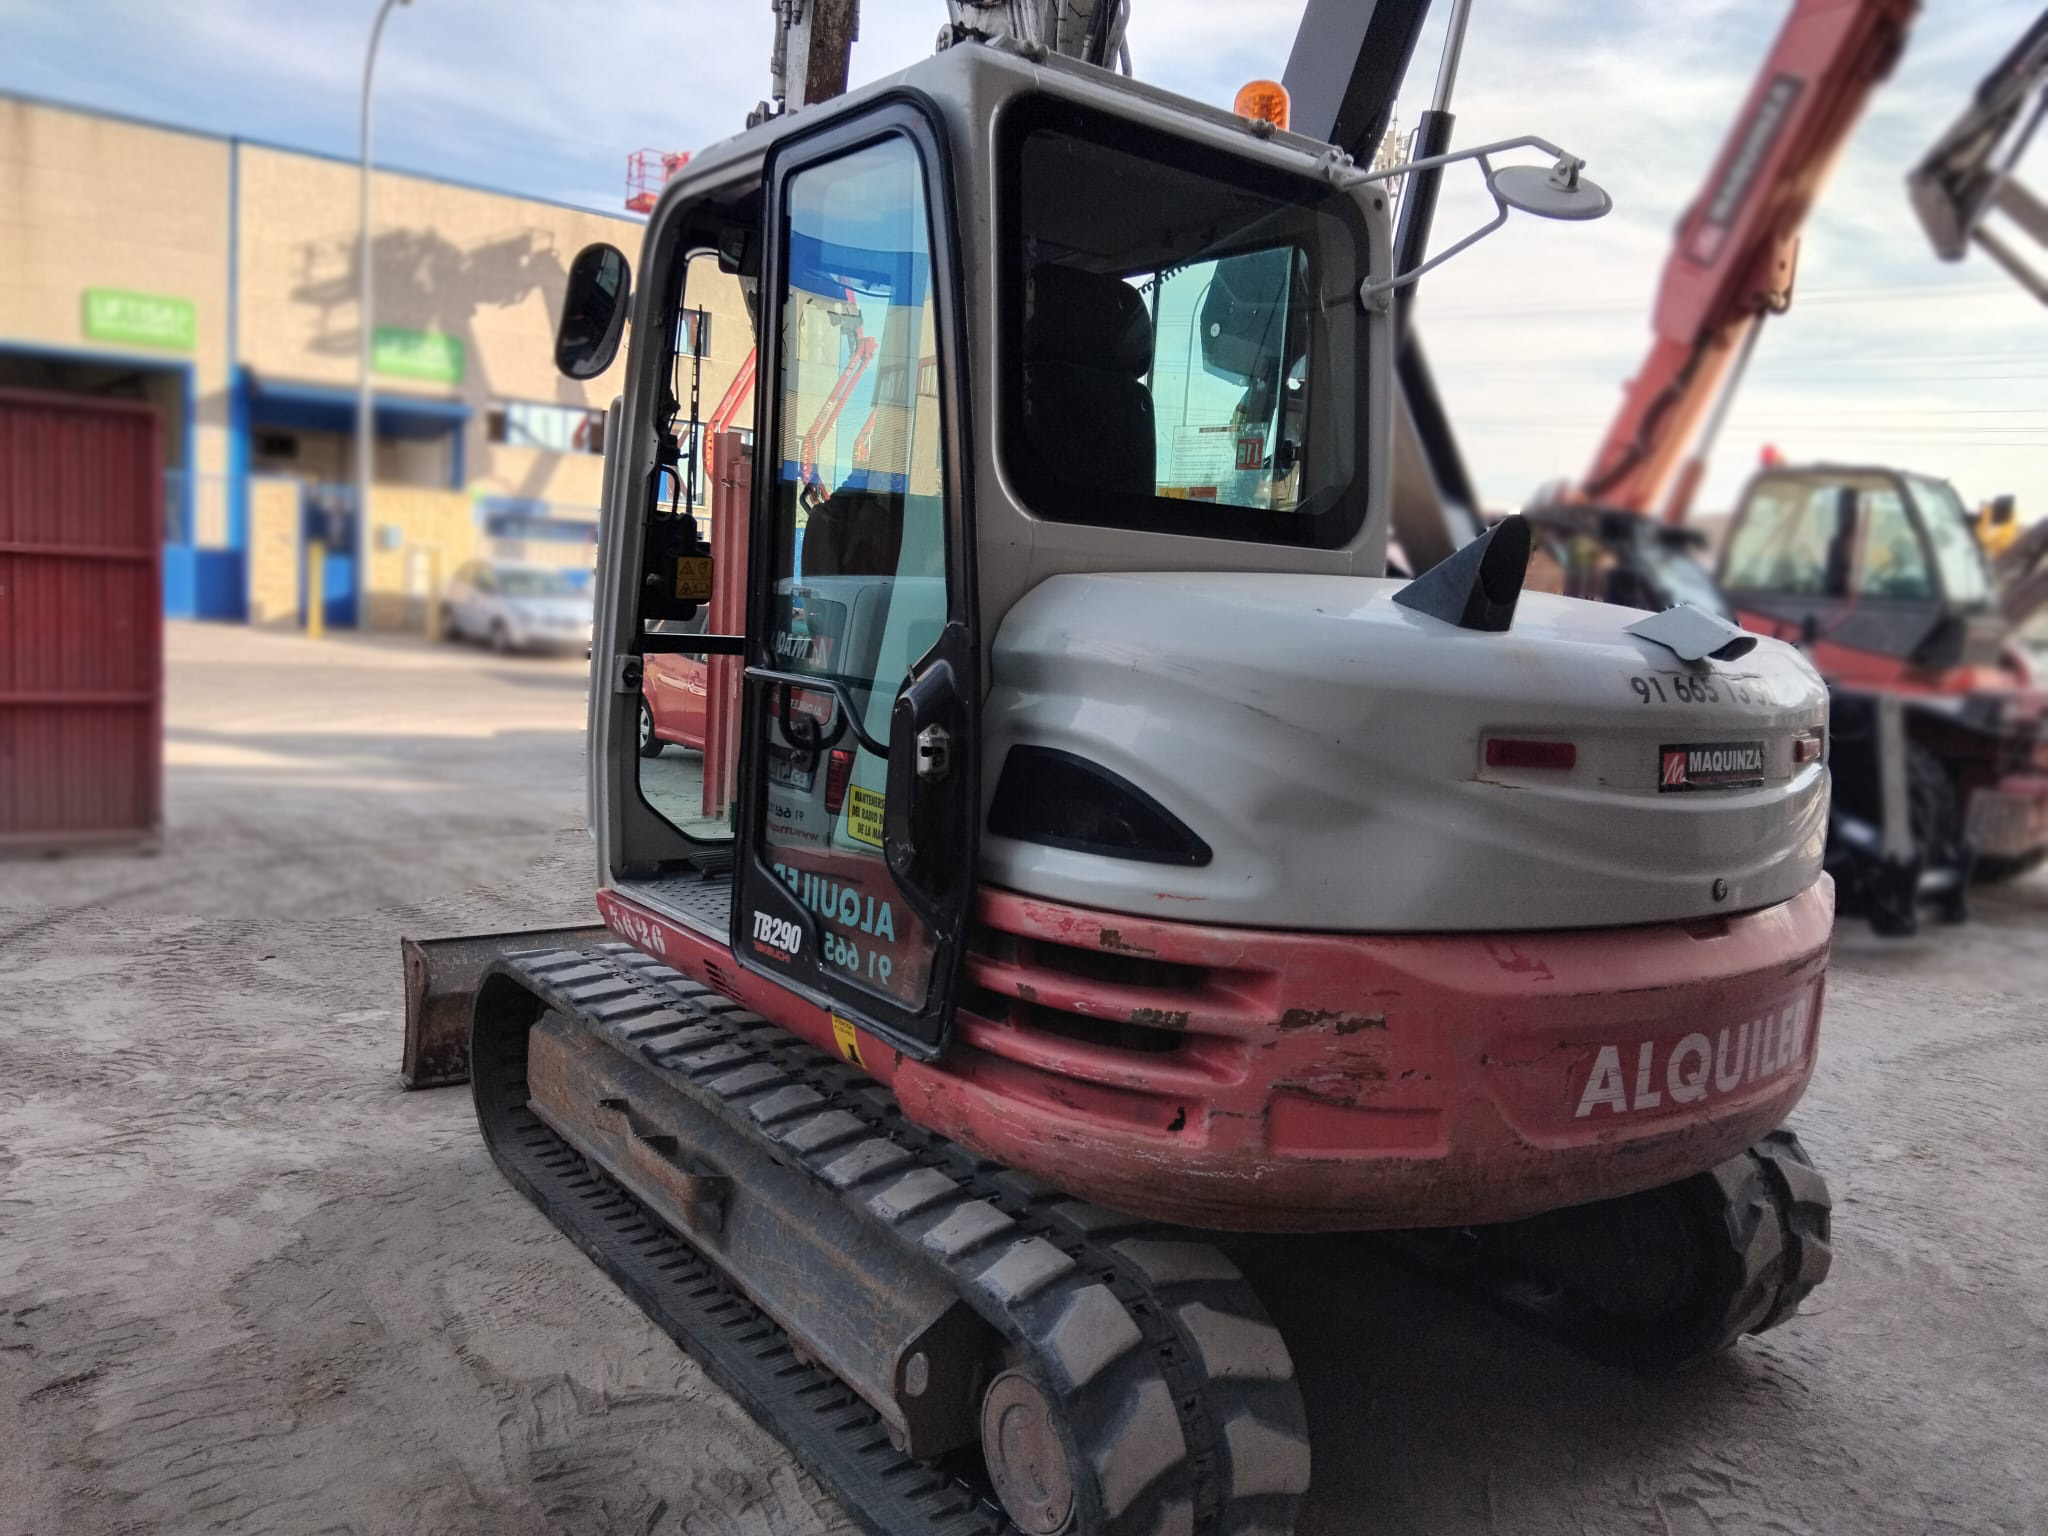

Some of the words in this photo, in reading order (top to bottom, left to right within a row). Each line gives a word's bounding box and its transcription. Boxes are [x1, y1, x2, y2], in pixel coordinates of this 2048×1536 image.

[1631, 677, 1667, 703] 91
[1674, 677, 1719, 704] 665
[1689, 750, 1761, 772] MAQUINZA
[753, 910, 802, 954] TB290
